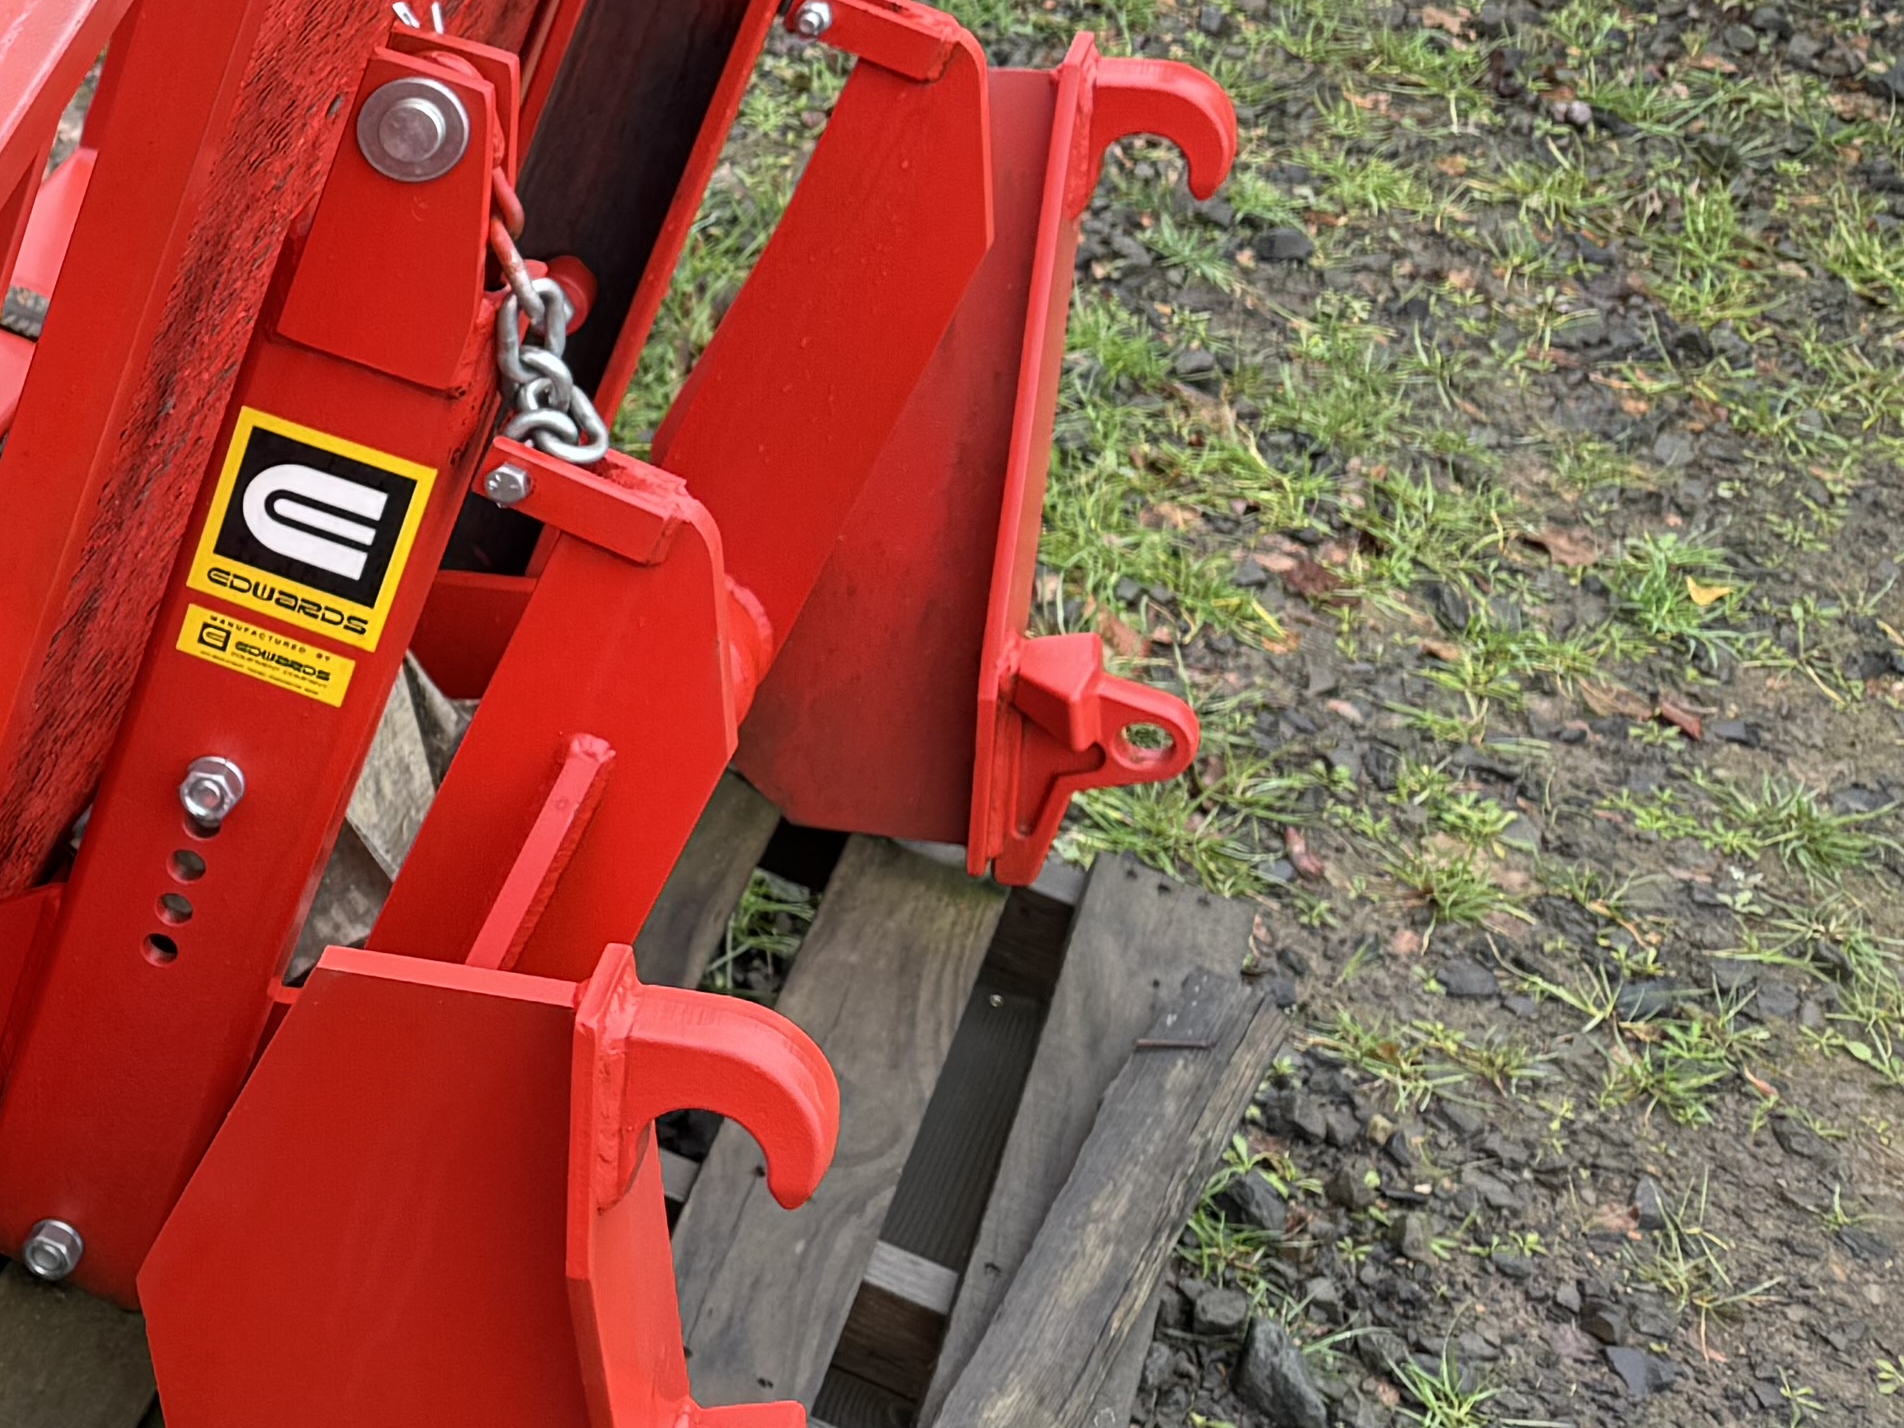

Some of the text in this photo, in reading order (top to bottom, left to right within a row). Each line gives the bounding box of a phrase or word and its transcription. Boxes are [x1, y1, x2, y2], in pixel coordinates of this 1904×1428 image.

[207, 567, 369, 635] EDWARDS
[210, 615, 331, 662] MANUFACTURED BY
[234, 640, 331, 682] EDWARDS
